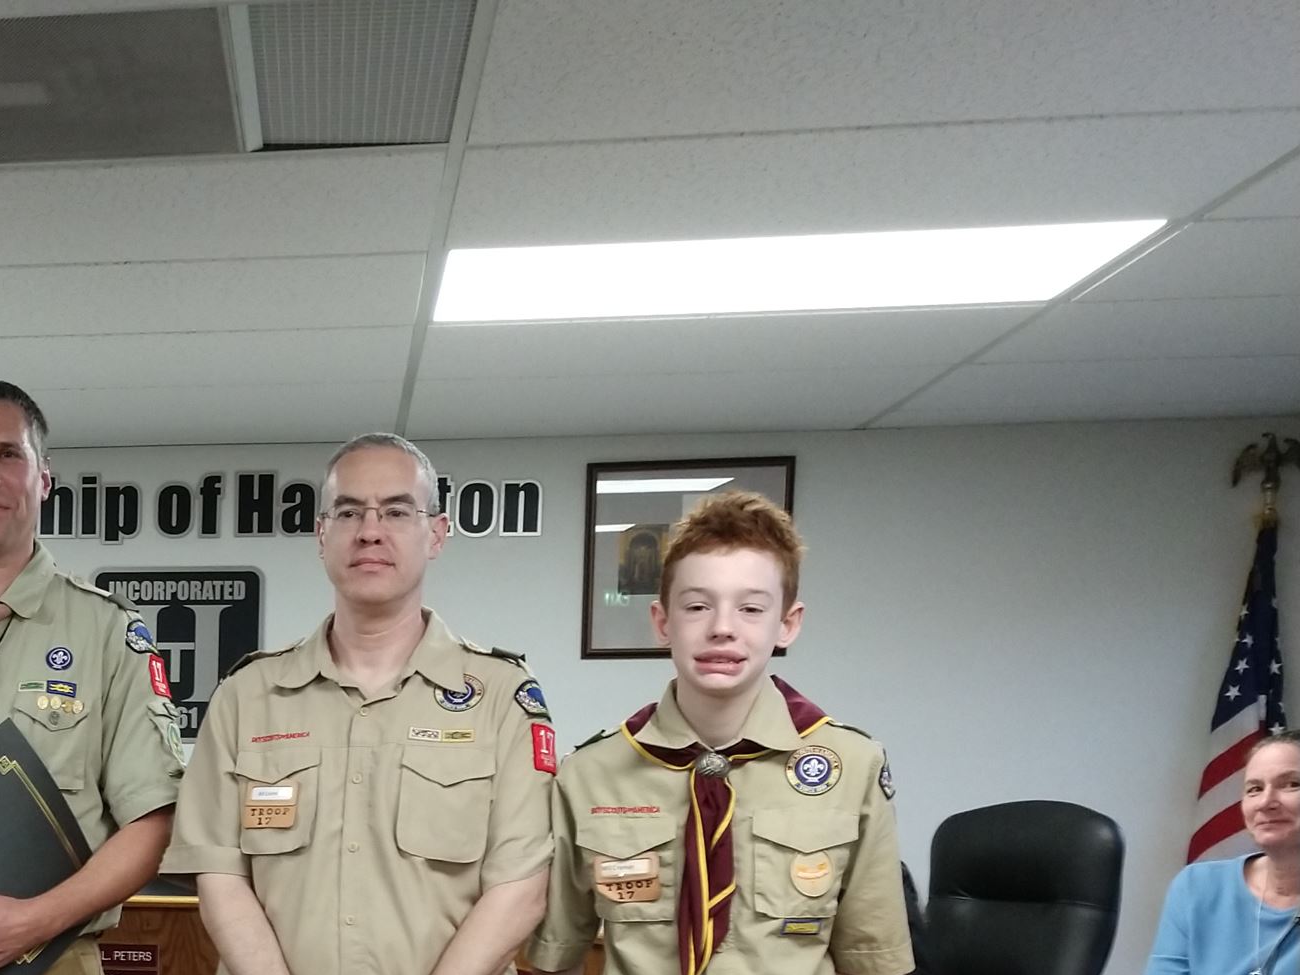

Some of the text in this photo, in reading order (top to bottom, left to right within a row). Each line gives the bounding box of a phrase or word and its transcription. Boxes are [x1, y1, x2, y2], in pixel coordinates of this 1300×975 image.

[157, 474, 223, 538] of
[235, 472, 543, 537] Haon
[108, 580, 247, 601] INCORPORATED
[540, 730, 555, 756] 17
[250, 807, 291, 817] TROOP
[257, 816, 272, 826] 17
[605, 879, 654, 892] TROOP
[617, 890, 636, 900] 17
[113, 950, 153, 962] PETERS
